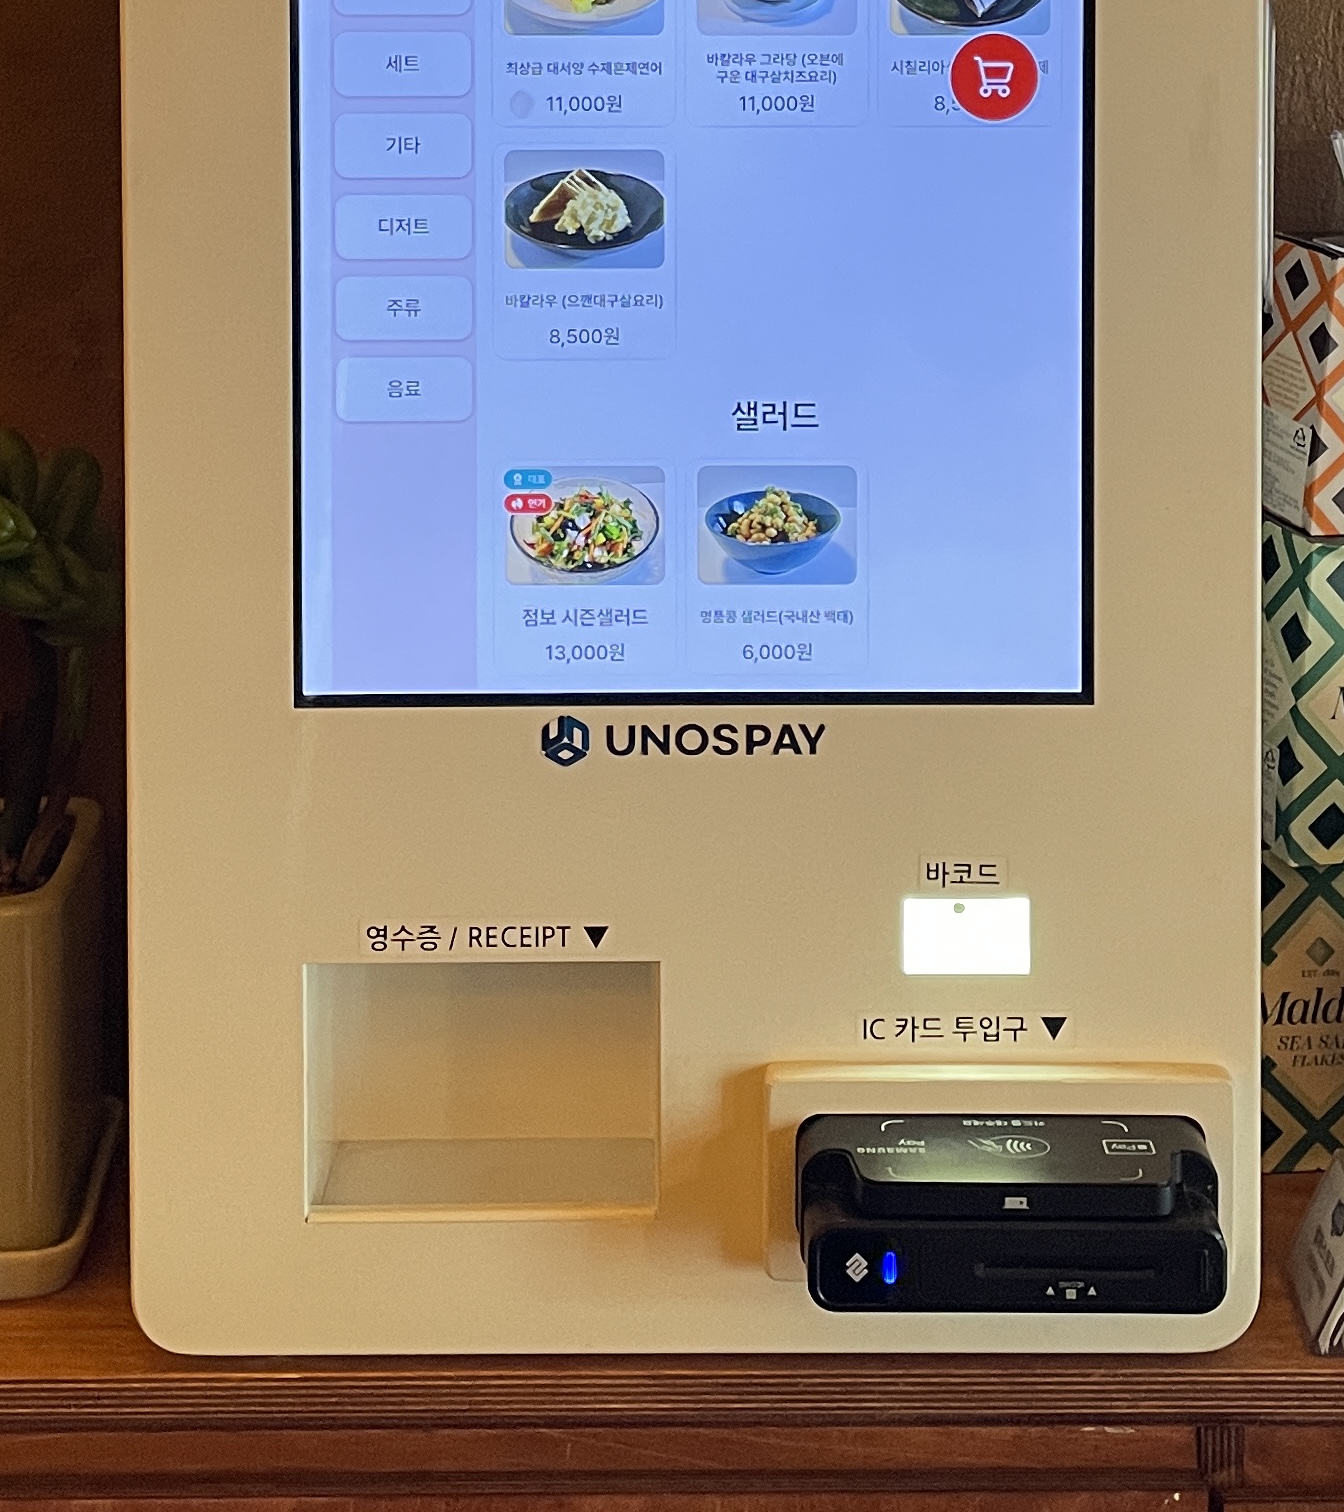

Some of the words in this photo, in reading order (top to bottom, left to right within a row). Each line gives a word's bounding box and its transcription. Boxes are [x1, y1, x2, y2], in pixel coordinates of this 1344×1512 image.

[385, 52, 420, 74] 세트
[505, 61, 543, 77] 최상급
[547, 61, 585, 77] 대서양
[706, 52, 756, 68] 바칼라우
[801, 52, 844, 69] (오븐에
[715, 70, 742, 84] 구운
[744, 70, 838, 85] 대구살치즈요리)
[545, 94, 623, 116] 11,000원
[738, 94, 816, 116] 11,000원
[385, 134, 421, 155] 기타
[377, 216, 430, 237] 디저트
[386, 297, 422, 319] 주류
[504, 293, 558, 309] 바칼라우
[548, 326, 621, 349] 8,500원
[386, 379, 422, 400] 음료
[731, 399, 820, 432] 샐러드
[521, 607, 556, 628] 점보
[561, 607, 649, 628] 시즌샐러드
[545, 643, 625, 665] 13,000원
[742, 643, 813, 665] 6,000원
[605, 723, 826, 756] UNOSPAY
[926, 860, 1002, 888] 바코드
[364, 923, 443, 953] 영수증
[467, 925, 572, 950] RECEIPT
[862, 1018, 887, 1042] IC
[894, 1016, 946, 1044] 카드
[952, 1015, 1029, 1044] 투입구
[1276, 1035, 1313, 1051] SEA
